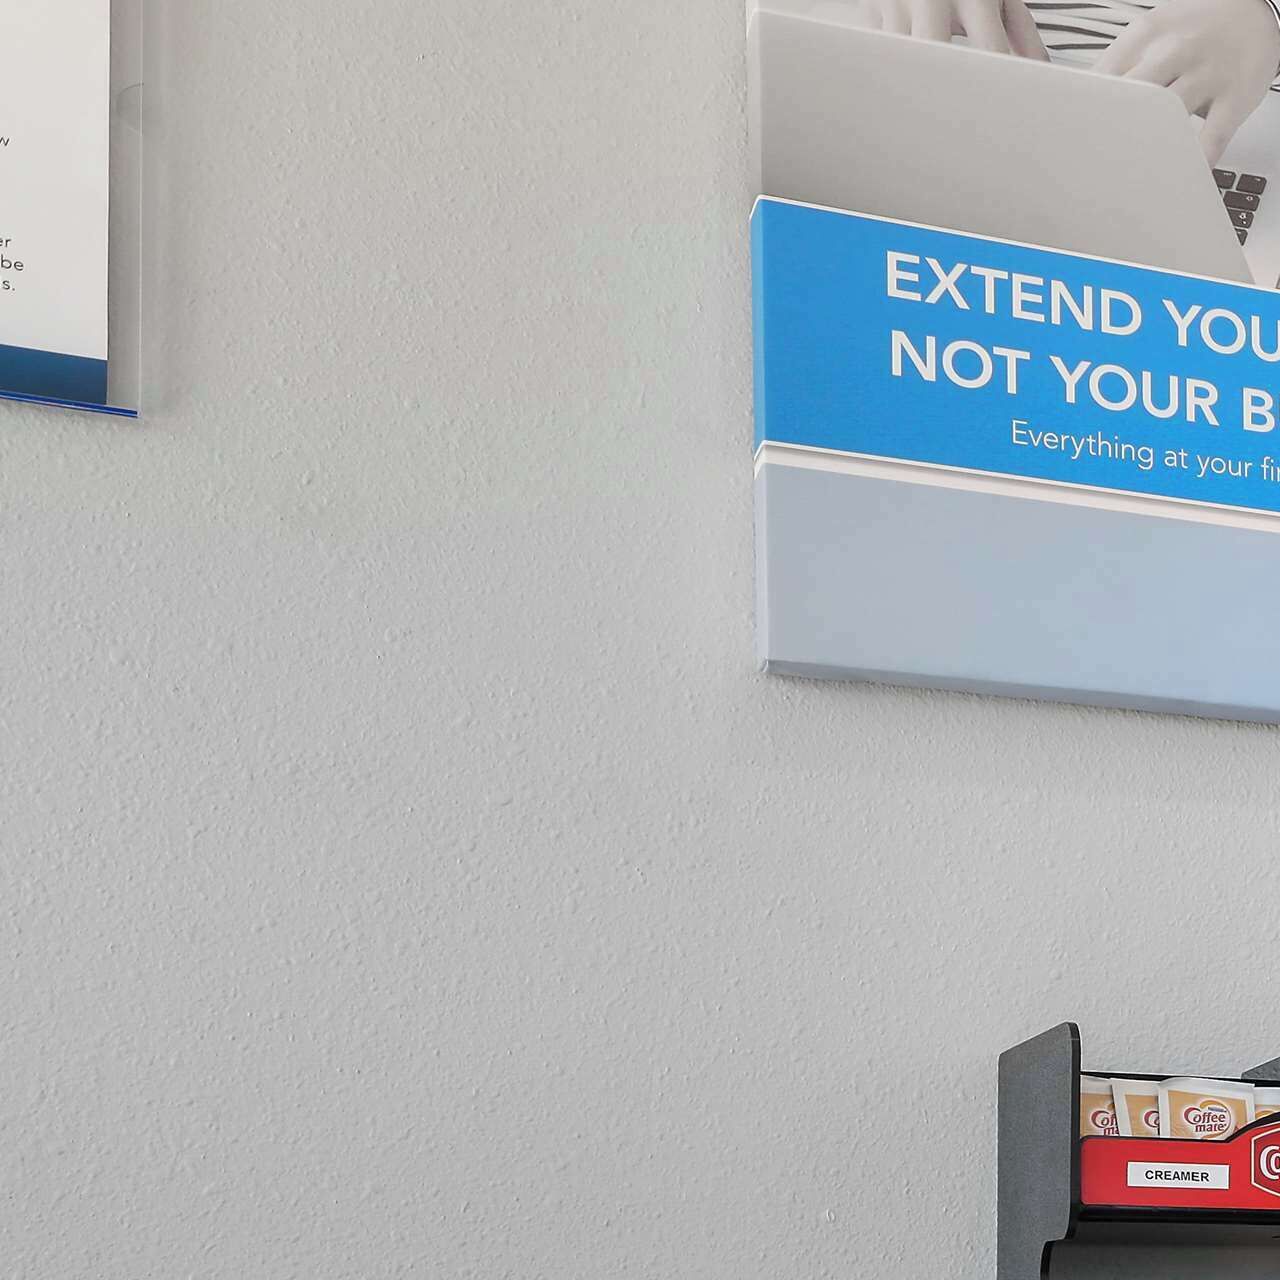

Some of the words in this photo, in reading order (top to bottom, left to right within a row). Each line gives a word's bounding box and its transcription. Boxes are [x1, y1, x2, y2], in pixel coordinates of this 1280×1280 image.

[886, 250, 1143, 337] EXTEND
[891, 329, 1031, 395] NOT
[1049, 356, 1220, 428] YOUR
[1011, 420, 1154, 469] Everything
[1164, 446, 1189, 468] at
[1196, 452, 1254, 480] your
[1184, 1107, 1226, 1128] Coffee
[1145, 1170, 1210, 1182] CREAMER
